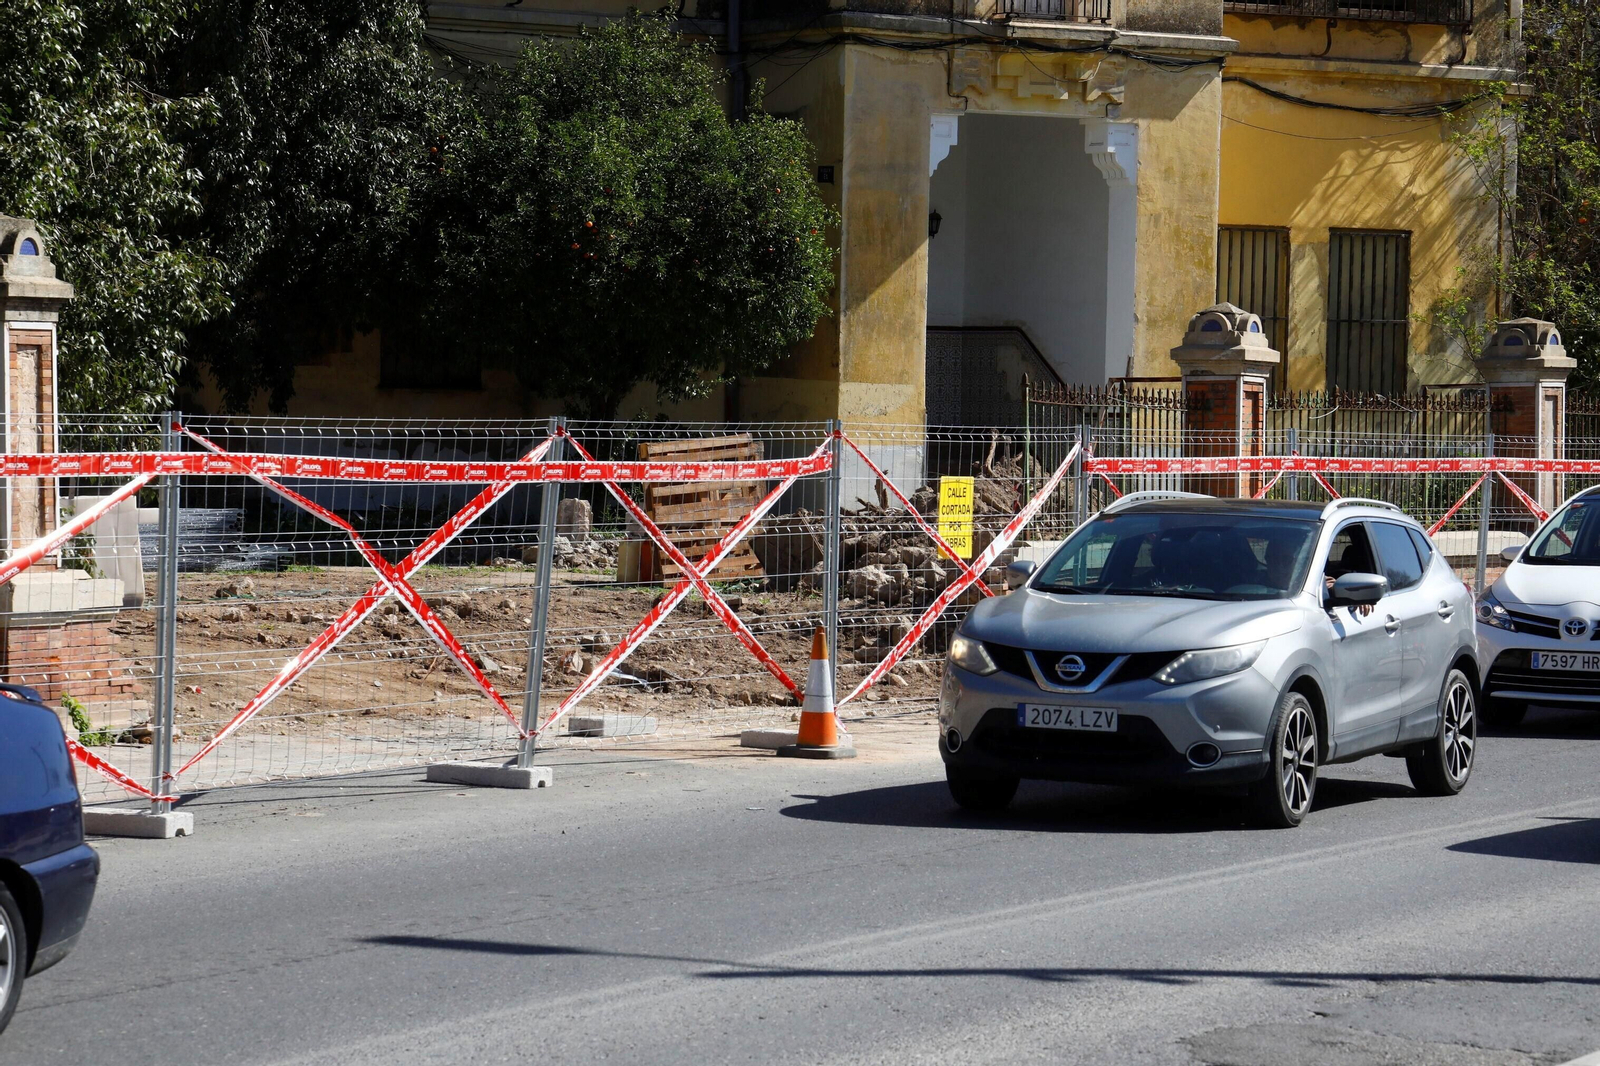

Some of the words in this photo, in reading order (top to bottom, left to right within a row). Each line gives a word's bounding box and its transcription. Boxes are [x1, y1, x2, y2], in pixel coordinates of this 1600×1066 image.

[947, 488, 967, 498] CALLE
[941, 504, 971, 516] CORTADA
[949, 522, 962, 531] POR
[945, 538, 967, 548] OBRAS
[1541, 654, 1578, 668] 7597
[1031, 708, 1074, 726] 2074
[1081, 710, 1114, 728] LZV
